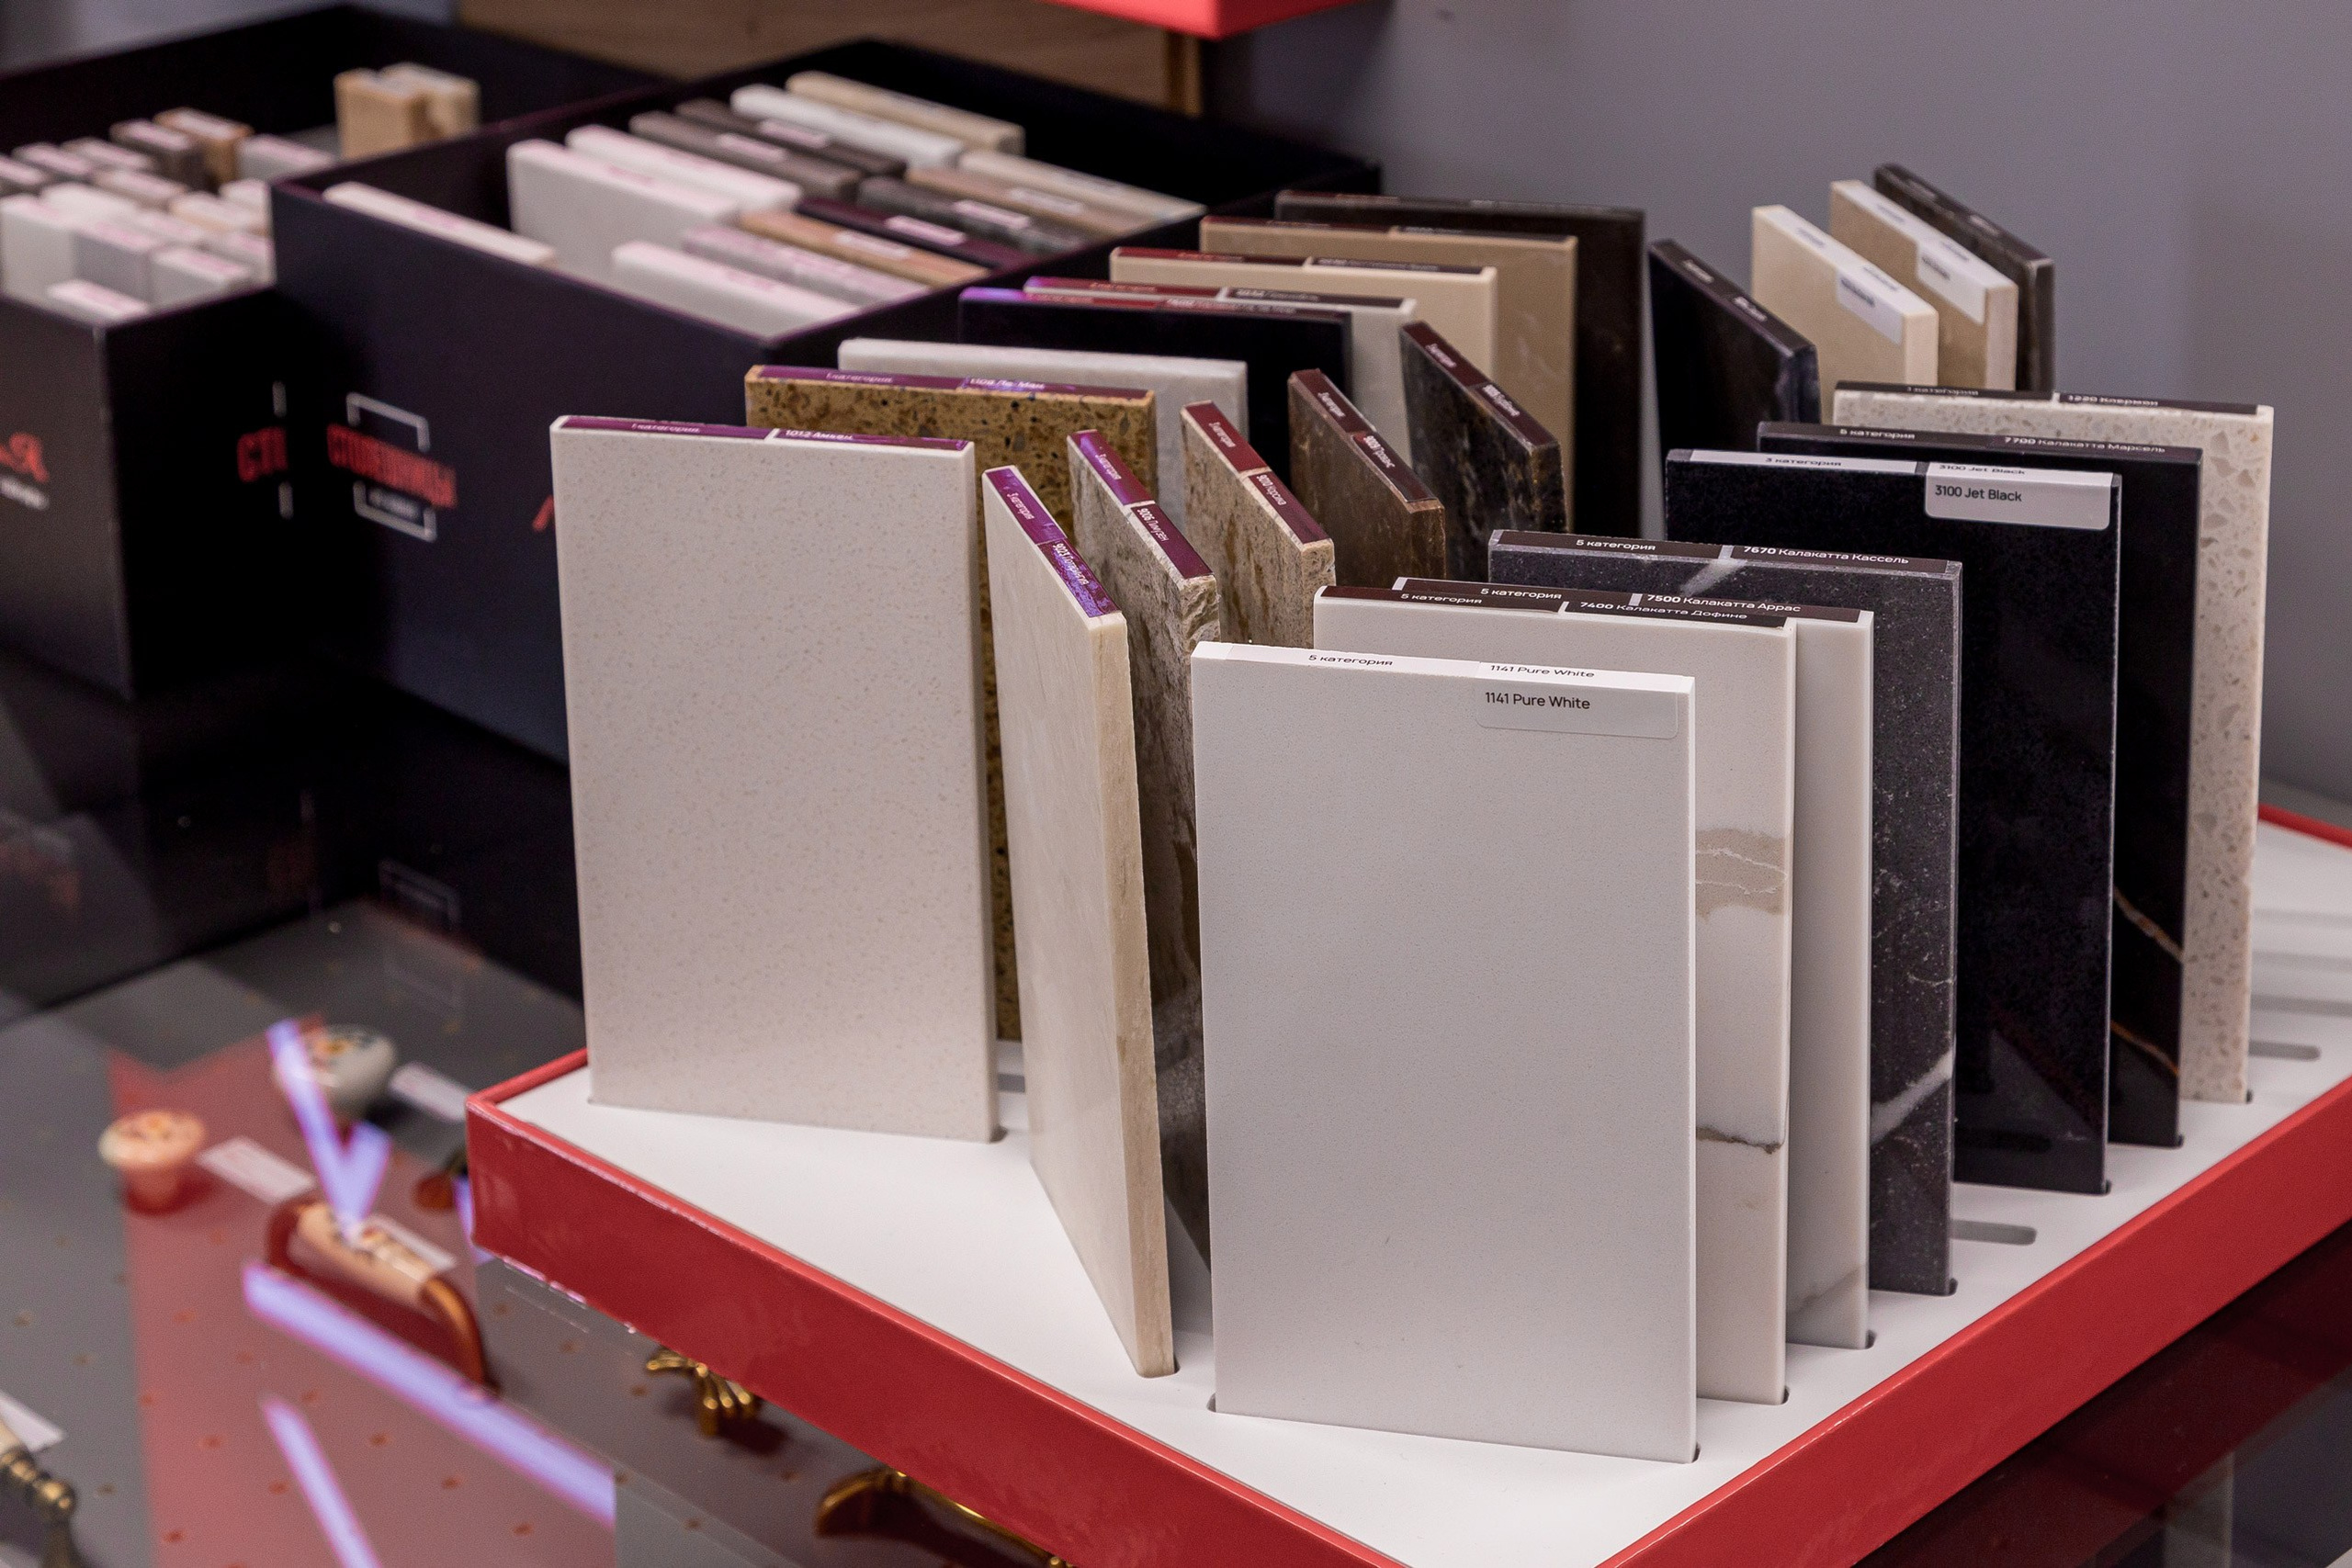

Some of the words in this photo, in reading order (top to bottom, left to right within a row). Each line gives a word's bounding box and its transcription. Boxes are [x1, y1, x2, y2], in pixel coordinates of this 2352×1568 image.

[784, 429, 811, 437] 1012
[1849, 429, 1916, 440] категория
[2004, 435, 2037, 446] 7700
[2038, 438, 2106, 450] Калакатта
[2108, 442, 2166, 453] Марсель
[1775, 458, 1842, 467] категория
[1990, 467, 2026, 475] Black
[1935, 485, 1962, 498] 3100
[1964, 487, 1985, 500] Jet
[1987, 488, 2022, 502] Black
[1587, 540, 1657, 551] категория
[1743, 546, 1777, 555] 7670
[1778, 547, 1850, 560] Калакатта
[1851, 553, 1910, 564] Кассель
[1412, 593, 1483, 604] категория
[1491, 589, 1562, 600] категория
[1580, 602, 1614, 610] 7400
[1616, 604, 1689, 616] Калакатта
[1647, 594, 1682, 604] 7500
[1682, 597, 1756, 609] Калакатта
[1757, 603, 1802, 614] Аррас
[1320, 655, 1394, 668] категория
[1490, 664, 1515, 672] 1141
[1517, 667, 1551, 675] Pure
[1554, 669, 1595, 678] White
[1485, 692, 1510, 705] 1141
[1513, 694, 1546, 706] Pure
[1548, 695, 1591, 710] White
